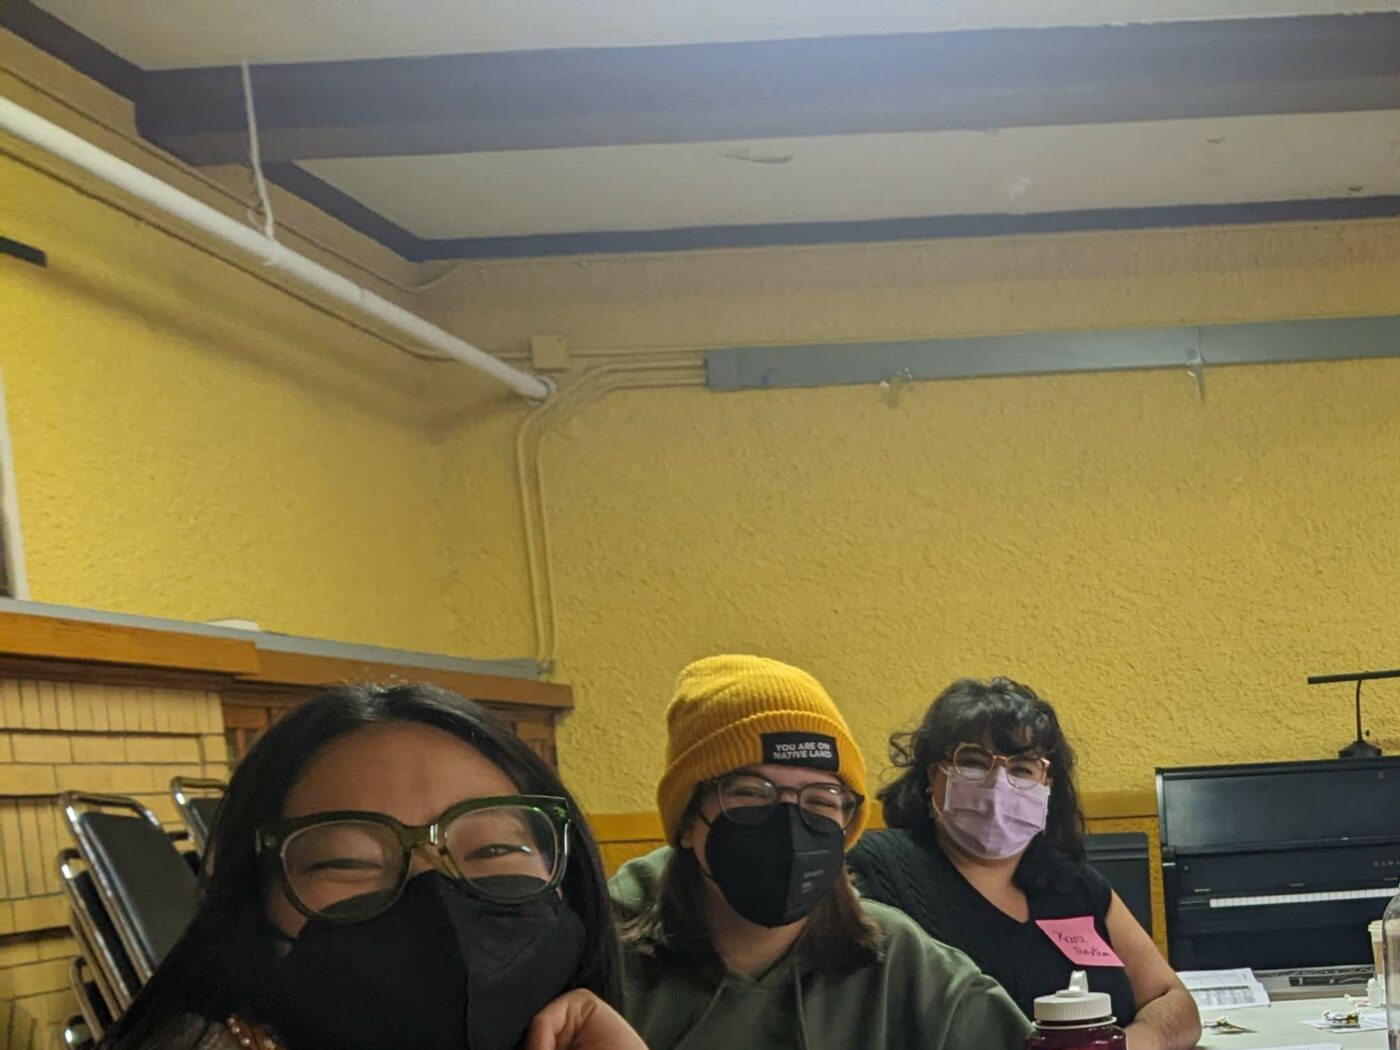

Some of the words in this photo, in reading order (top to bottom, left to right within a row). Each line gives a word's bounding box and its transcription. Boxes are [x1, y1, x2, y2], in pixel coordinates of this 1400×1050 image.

[775, 744, 795, 752] YOU
[797, 742, 815, 750] ARE
[817, 741, 830, 750] ON
[773, 750, 808, 760] NATIVE
[809, 750, 832, 759] LAND
